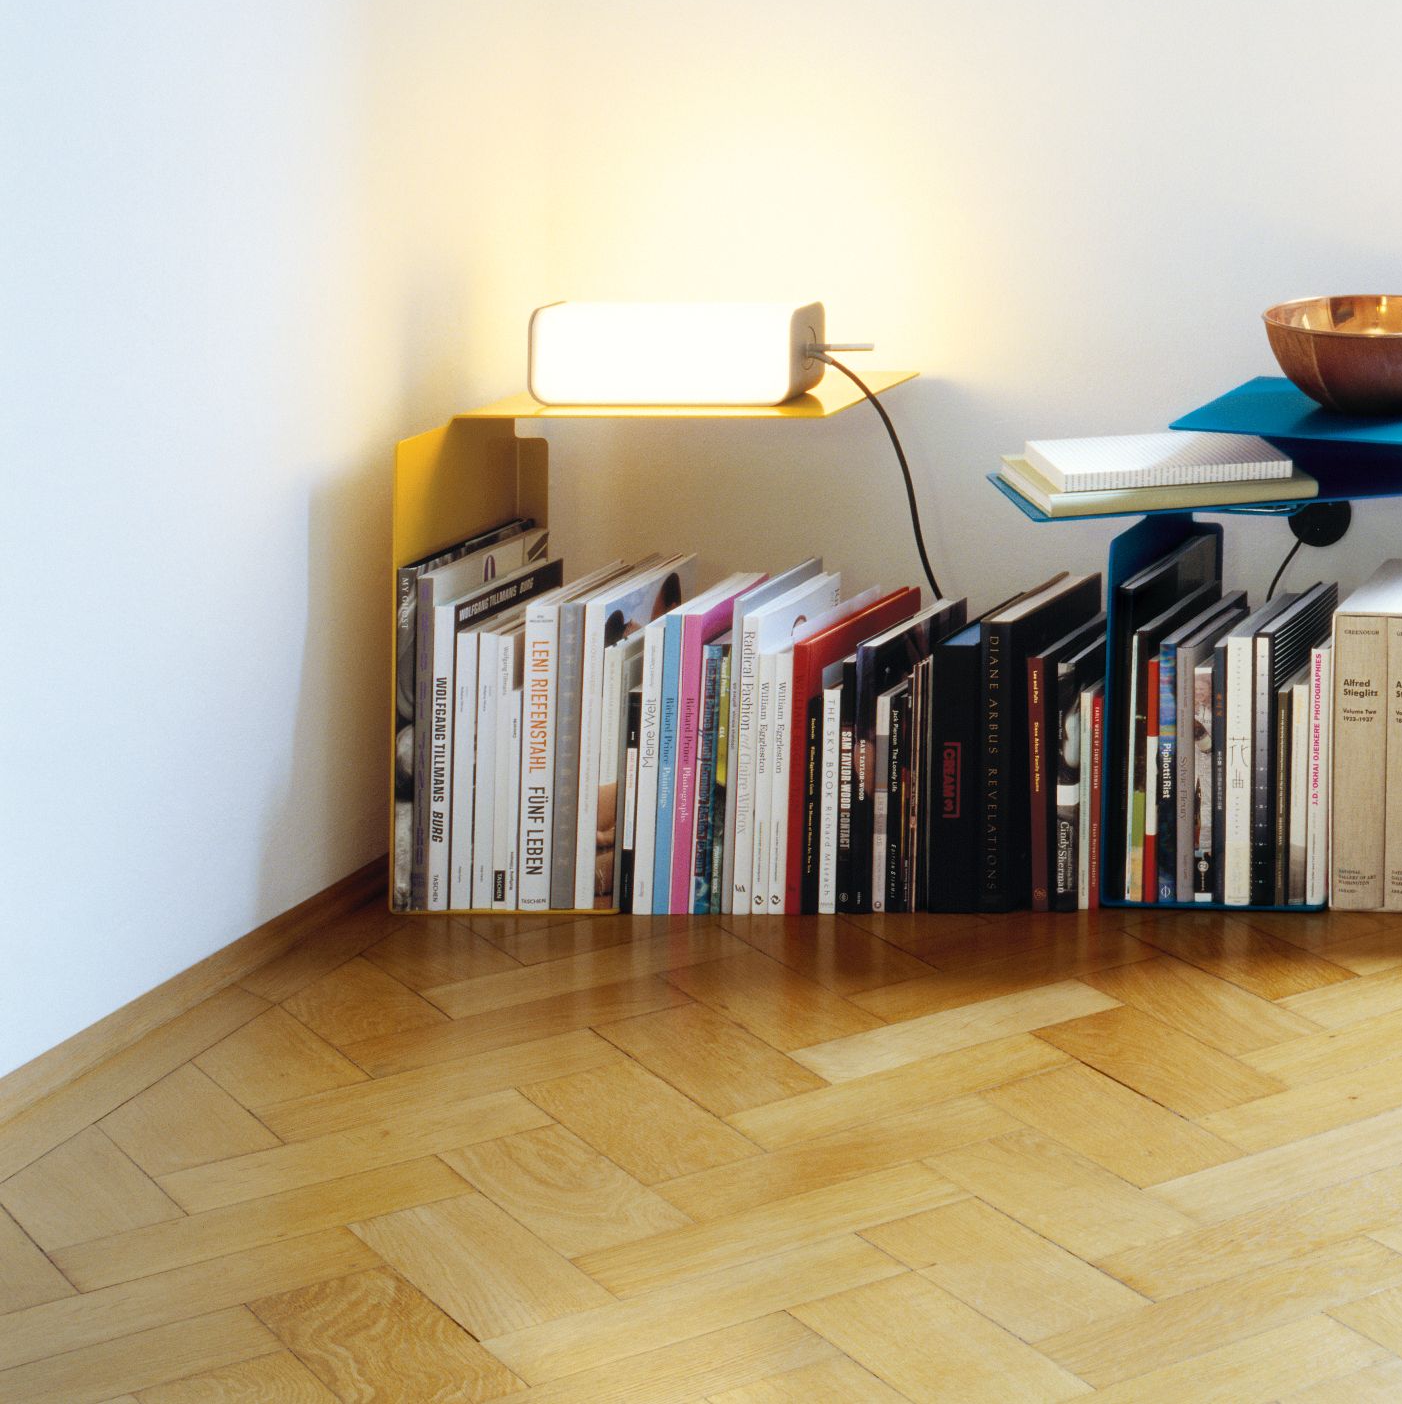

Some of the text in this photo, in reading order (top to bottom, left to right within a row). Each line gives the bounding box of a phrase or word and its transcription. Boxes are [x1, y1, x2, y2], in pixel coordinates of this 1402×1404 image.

[401, 577, 409, 593] MY
[459, 577, 534, 622] WOLFGANG TILLMANS BURG
[742, 631, 756, 678] Radical
[434, 677, 447, 741] WOLFGANG
[740, 683, 754, 731] Fashion
[1343, 679, 1371, 688] Alfred
[1343, 689, 1378, 698] Stieglitz
[642, 697, 657, 768] Meine Welt
[660, 698, 675, 808] Richard Prince Paintings
[757, 682, 770, 774] William Eggleston
[432, 744, 445, 803] TILLMANS
[526, 640, 549, 875] LENI RIEFENSTAHL FÜNF LEBEN
[678, 698, 694, 822] Richard Prince Photographs
[738, 753, 750, 791] Claire
[943, 749, 955, 796] CREAM
[987, 635, 999, 890] DIANE ARBUS REVELATIONS
[1161, 743, 1171, 798] Pipilotti Rist
[736, 793, 750, 835] Wilcox
[823, 699, 835, 896] THE SKY BOOK Richard Misrach
[839, 731, 852, 848] SAM TAYLOR-WOOD CONTACT
[431, 810, 443, 843] BURG
[1057, 821, 1069, 893] Cindy Sherman
